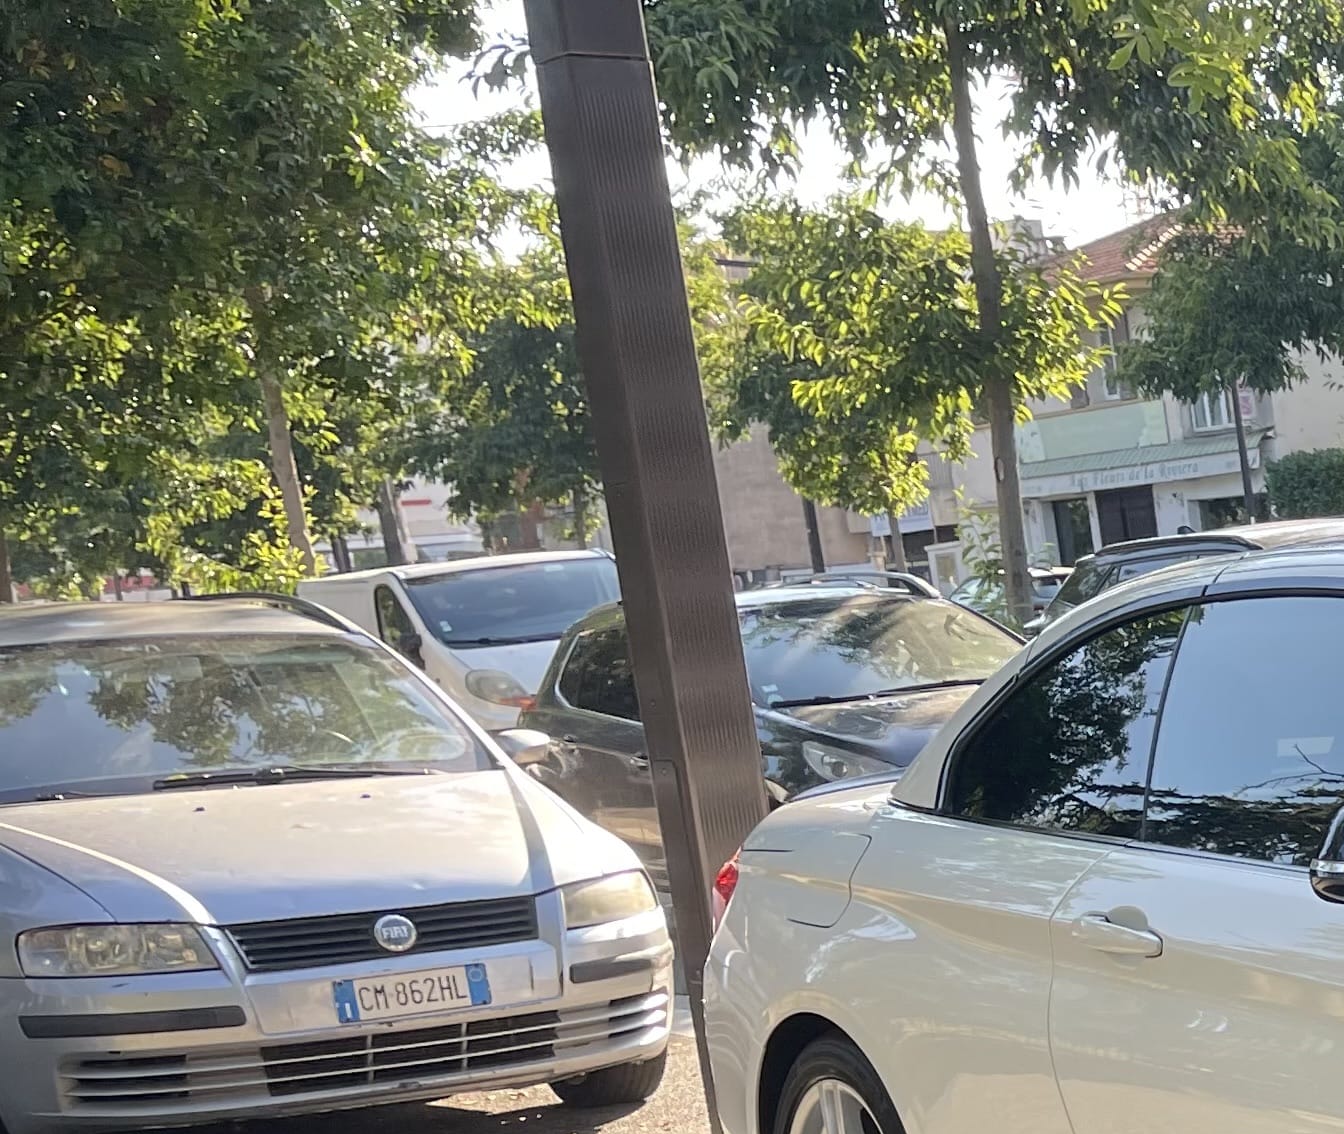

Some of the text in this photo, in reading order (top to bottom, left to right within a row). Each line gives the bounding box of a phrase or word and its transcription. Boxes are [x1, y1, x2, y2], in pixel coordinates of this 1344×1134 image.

[382, 926, 409, 939] FIAT
[359, 975, 468, 1012] CM 862HL
